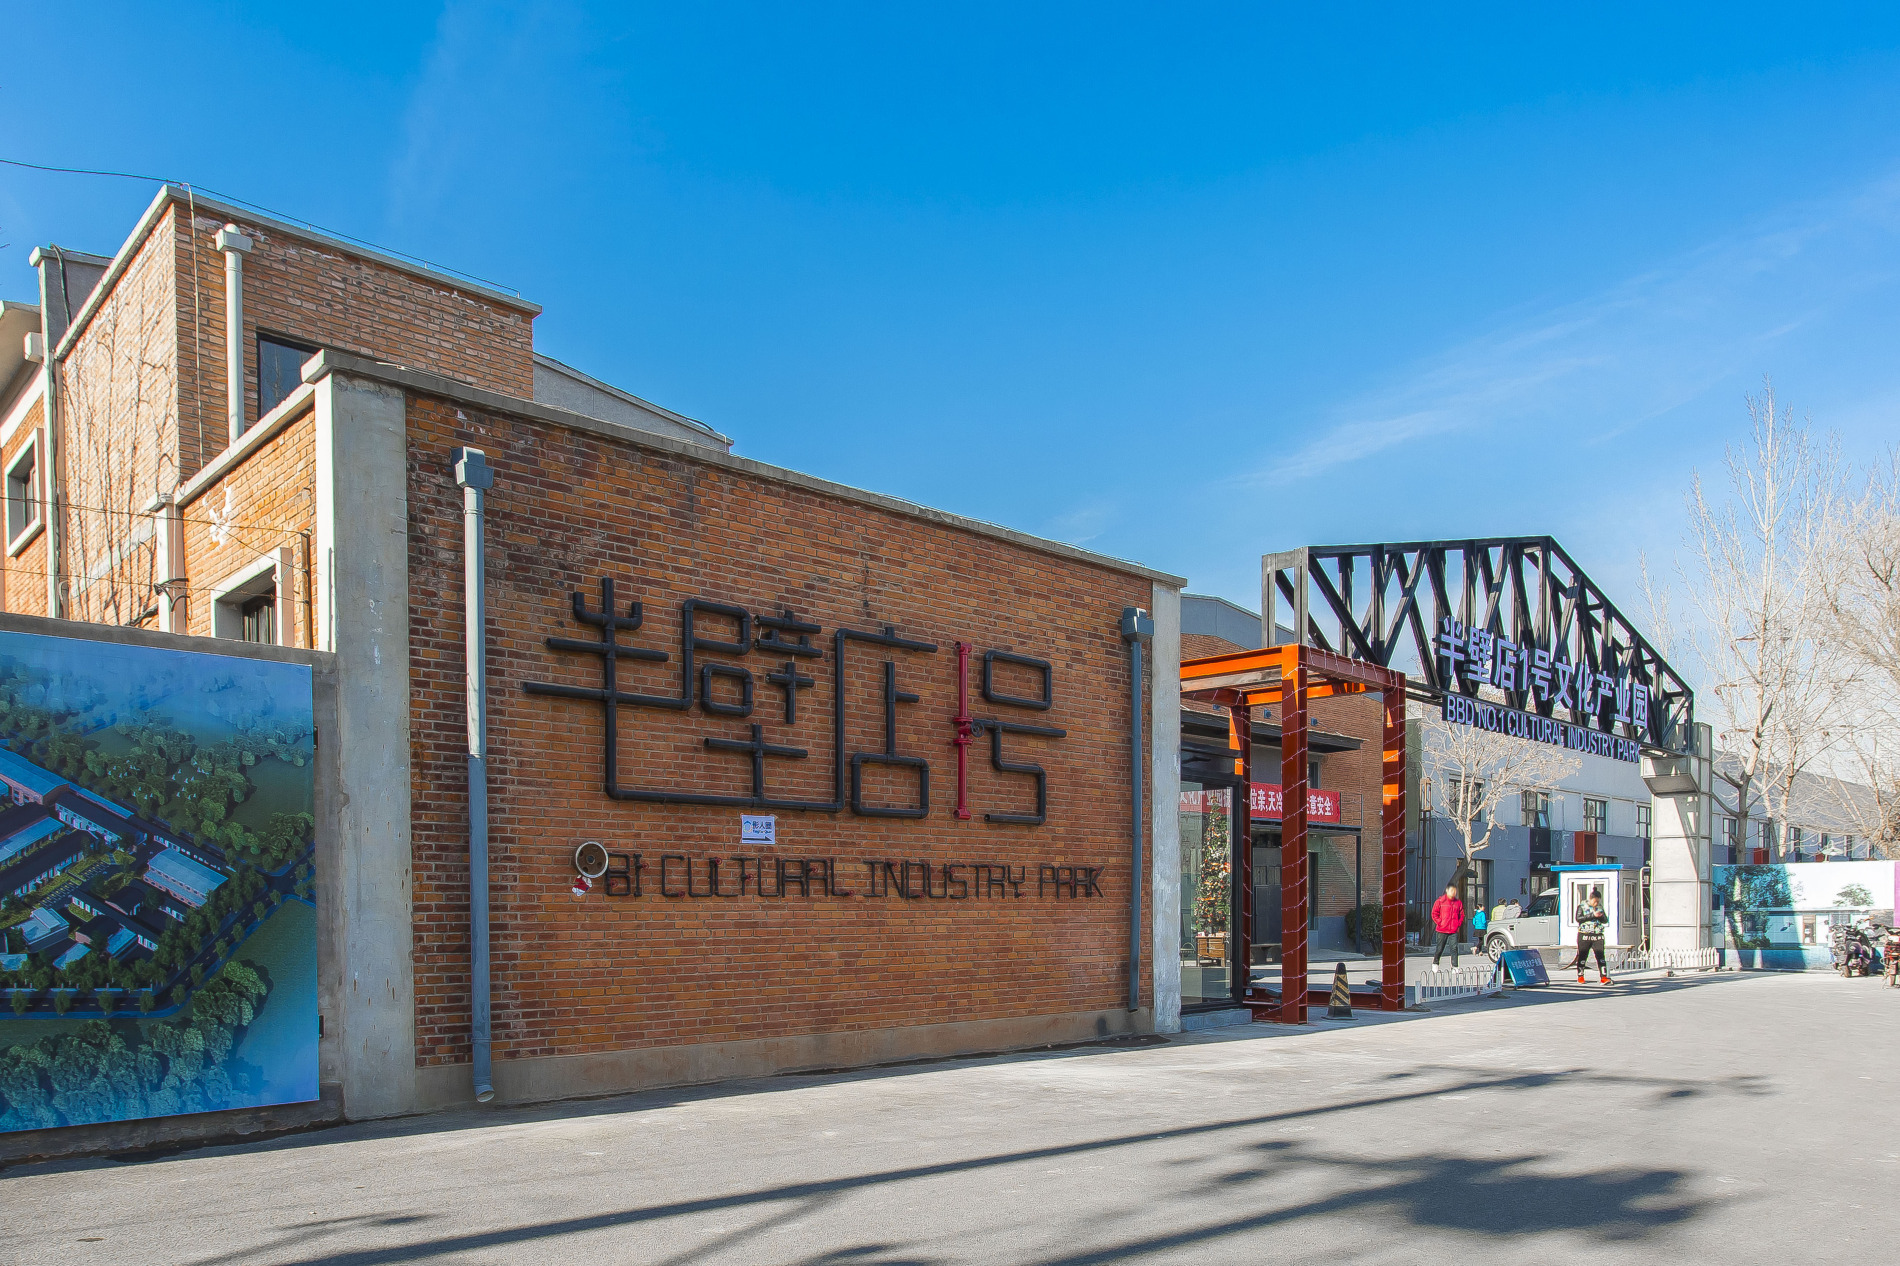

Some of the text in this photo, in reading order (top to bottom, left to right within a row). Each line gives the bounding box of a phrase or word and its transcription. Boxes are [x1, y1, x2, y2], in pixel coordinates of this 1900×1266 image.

[1438, 616, 1648, 728] 半壁店1号文化产业园
[1446, 695, 1641, 763] BBD NO.1 CULTURAL INDUSTRY PARK
[661, 854, 855, 898] CULTURAL
[863, 859, 1027, 899] INDUSTRY
[1040, 864, 1105, 899] PARK
